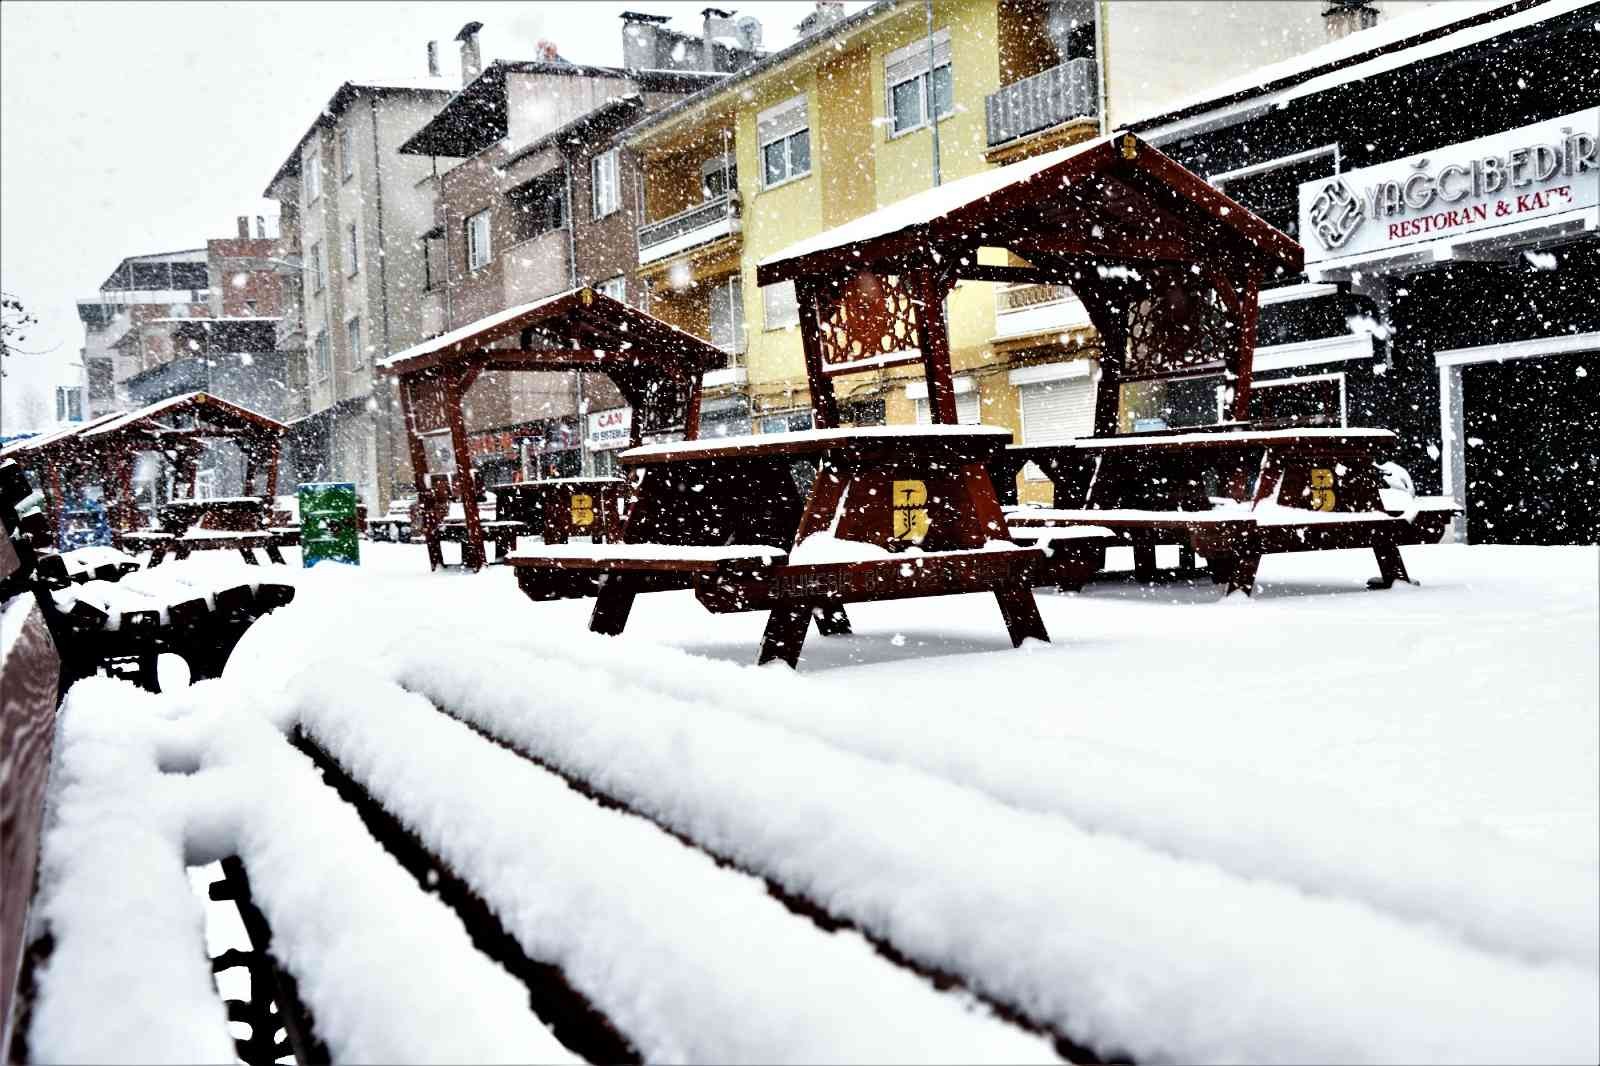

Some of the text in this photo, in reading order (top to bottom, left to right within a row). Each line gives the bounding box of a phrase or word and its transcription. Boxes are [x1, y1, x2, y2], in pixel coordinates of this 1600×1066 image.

[1365, 127, 1600, 220] YAĞCIBEDİR
[1387, 203, 1488, 241] RESTORAN
[1495, 200, 1511, 218] &
[598, 411, 623, 428] CAN
